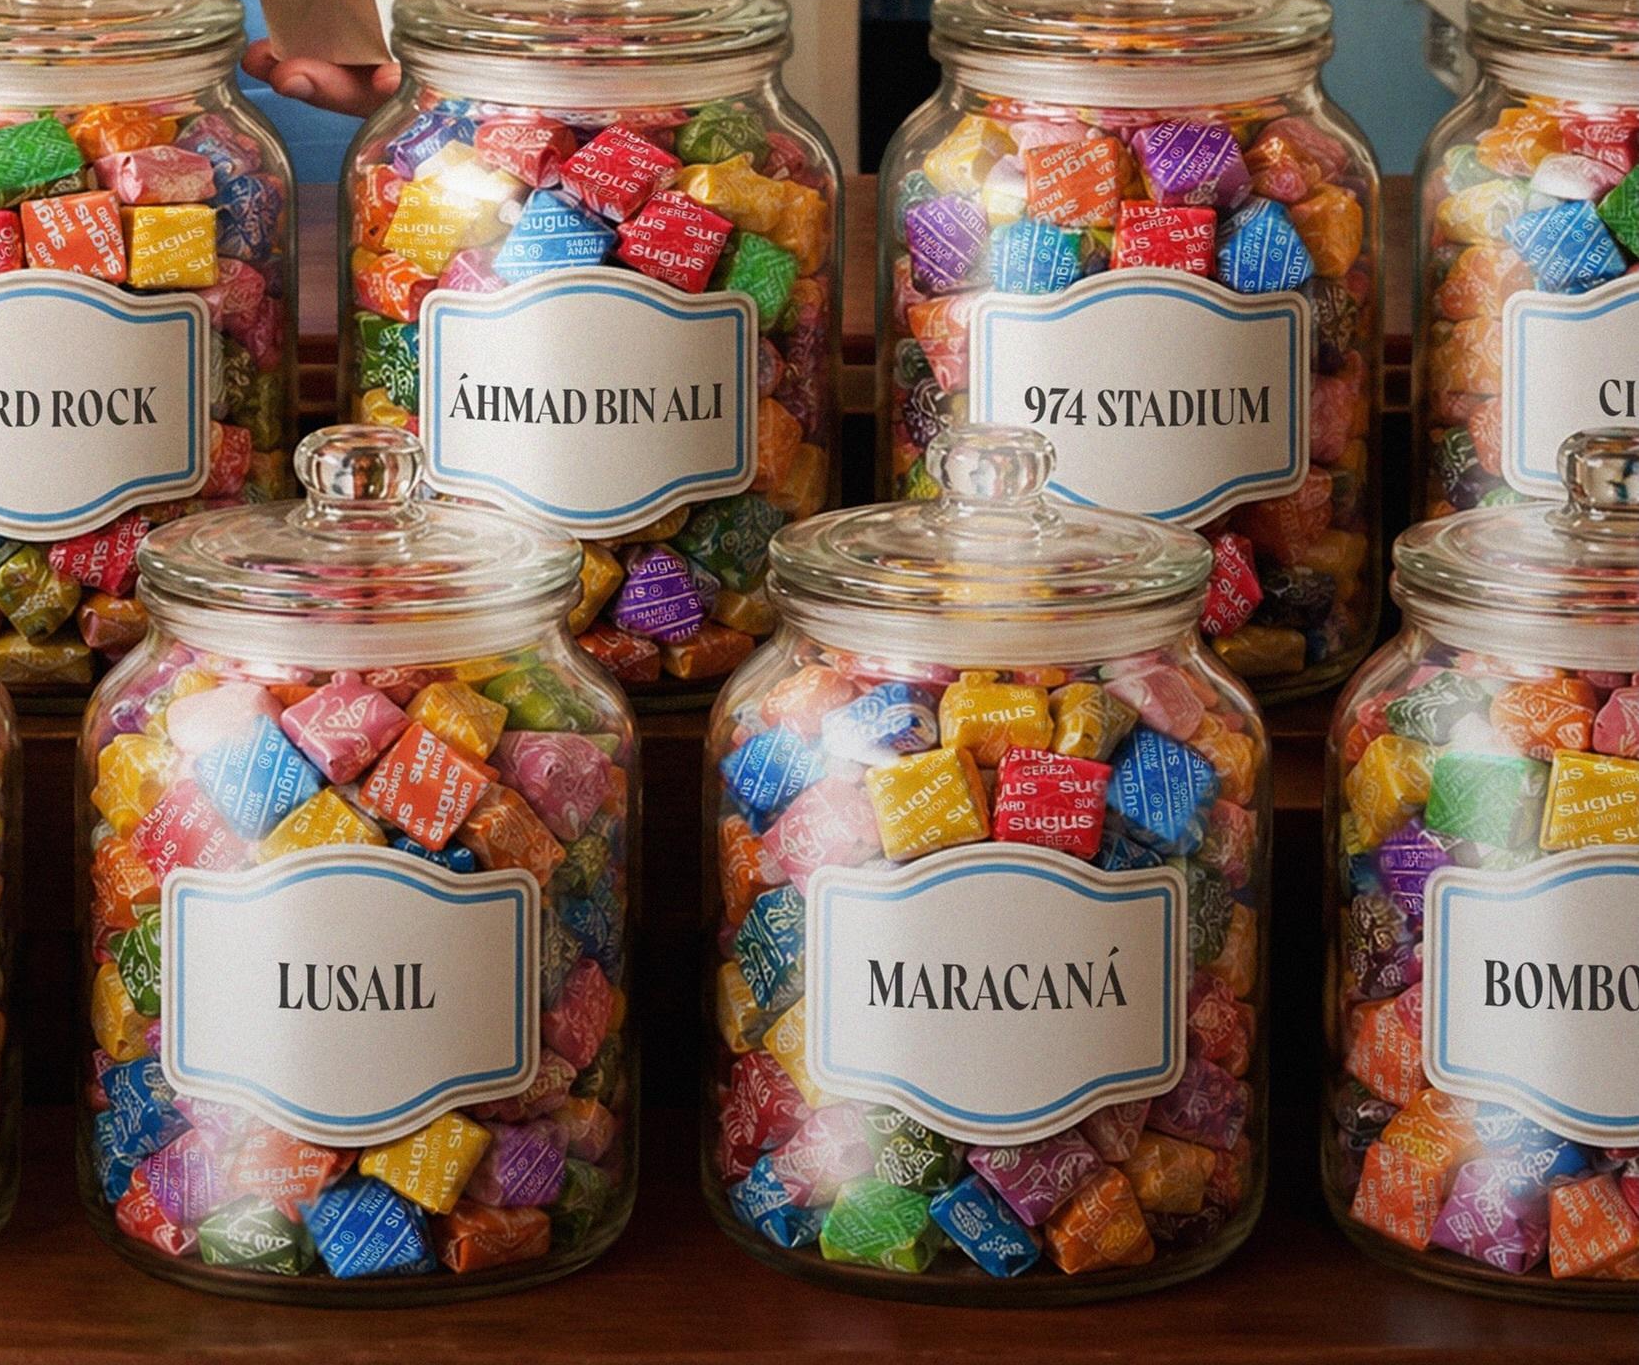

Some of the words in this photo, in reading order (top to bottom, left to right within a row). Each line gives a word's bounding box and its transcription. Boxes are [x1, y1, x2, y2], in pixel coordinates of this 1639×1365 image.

[609, 135, 650, 156] CEREZA
[570, 162, 640, 194] sugus
[1035, 142, 1109, 191] sugus
[392, 220, 456, 238] sugus
[520, 212, 582, 234] sugus
[657, 204, 703, 223] CEREZA
[1133, 214, 1183, 233] CEREZA
[74, 202, 123, 277] sugus
[135, 226, 206, 260] sugus
[629, 242, 706, 271] sugus
[50, 386, 159, 428] ROCK
[449, 372, 588, 425] ÁHMAD
[594, 388, 657, 425] BIN
[662, 382, 724, 423] ALI
[1024, 387, 1086, 426] 974
[1096, 385, 1272, 428] STADIUM
[1599, 379, 1636, 418] CI
[644, 612, 679, 628] ANDOS
[273, 755, 302, 814] sugus
[1022, 763, 1075, 777] CEREZA
[428, 763, 462, 843] sugus
[884, 770, 954, 827] sugus
[1121, 757, 1140, 818] sugus
[1556, 789, 1637, 818] sugus
[914, 796, 948, 826] LIMON
[1008, 814, 1095, 835] sugus
[277, 962, 437, 1012] LUSAIL
[867, 946, 1129, 1012] MARACANÁ
[1484, 959, 1639, 1012] BOMBO
[239, 1165, 317, 1184] sugus
[363, 1241, 391, 1269] ANDOS
